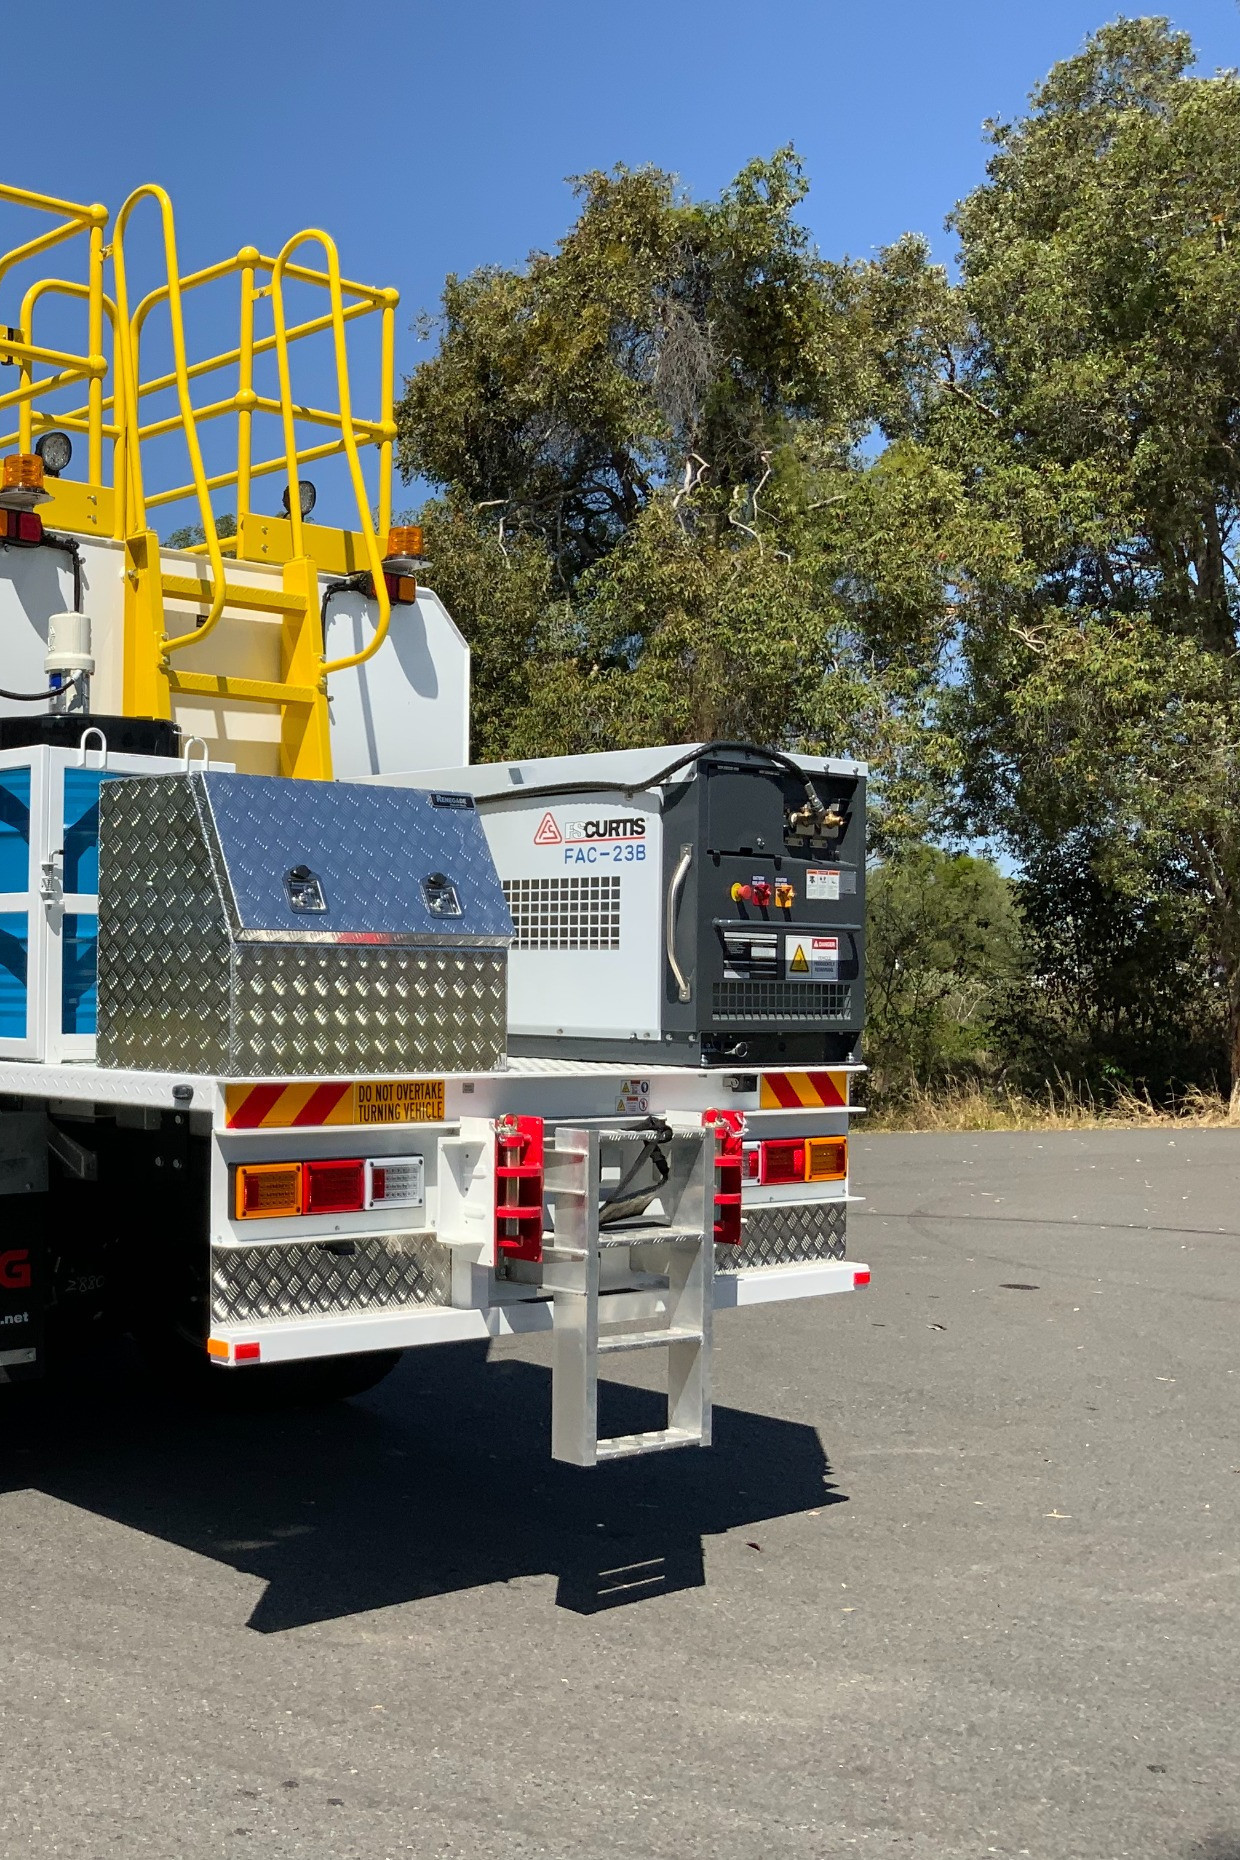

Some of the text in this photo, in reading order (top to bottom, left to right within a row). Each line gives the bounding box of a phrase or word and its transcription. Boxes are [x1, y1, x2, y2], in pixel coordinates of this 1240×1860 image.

[564, 844, 646, 864] FAC-23B
[358, 1084, 373, 1103] DO
[375, 1083, 394, 1102] NOT
[396, 1082, 443, 1101] OVERTAKE
[358, 1102, 401, 1123] TURNING
